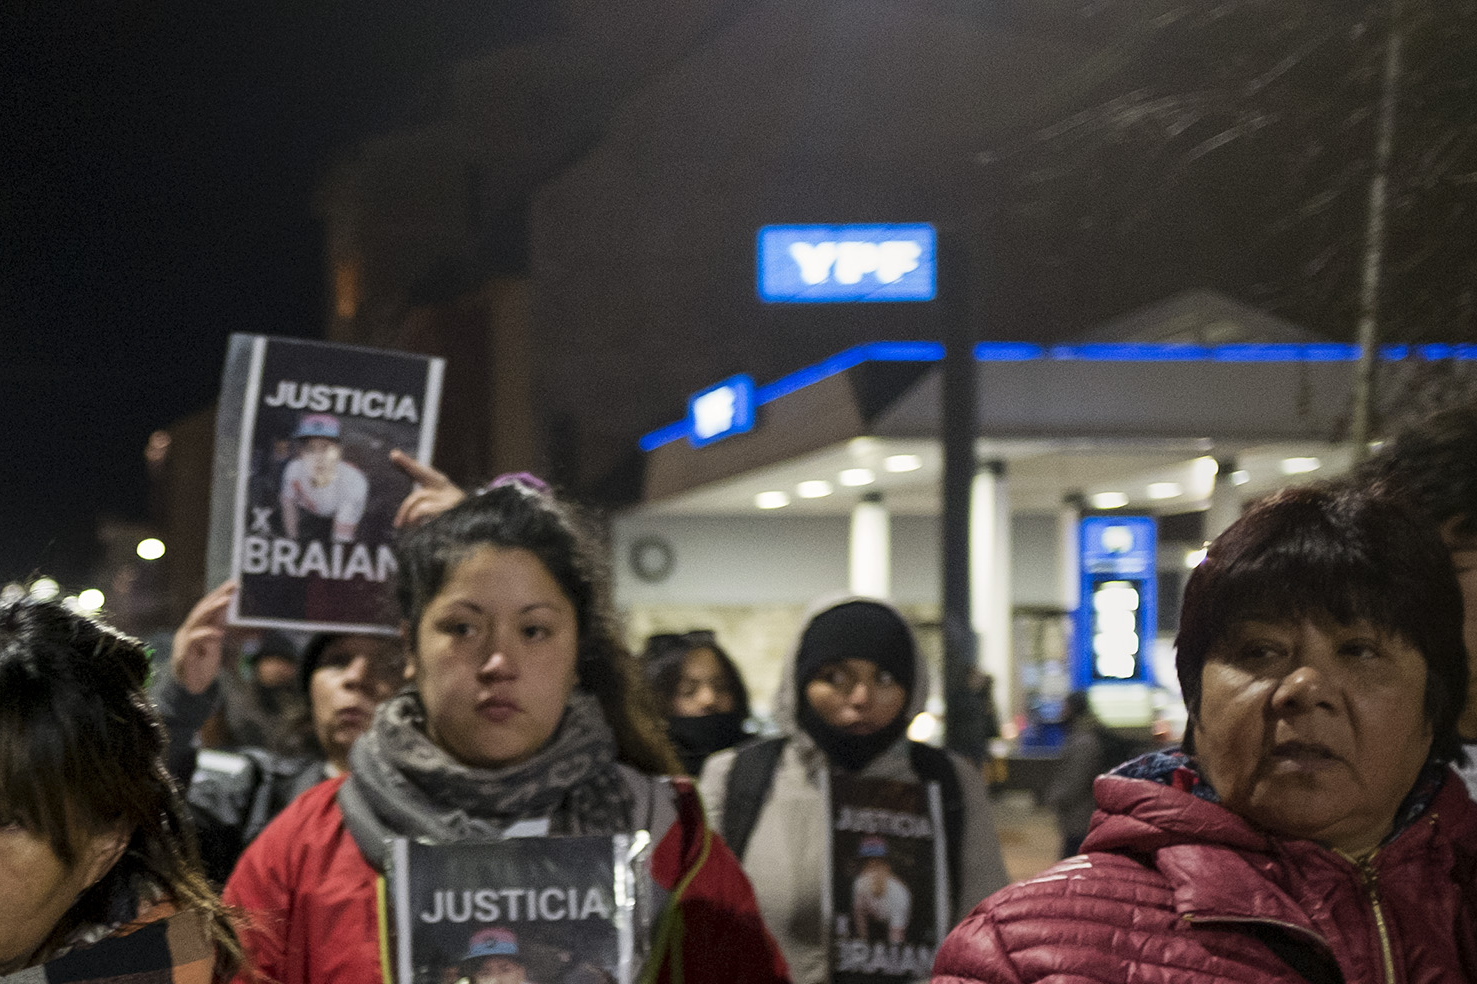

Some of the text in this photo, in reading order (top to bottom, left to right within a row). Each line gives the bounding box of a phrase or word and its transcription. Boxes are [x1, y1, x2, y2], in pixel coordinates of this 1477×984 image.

[789, 240, 922, 286] YPF
[265, 380, 419, 424] JUSTICIA
[422, 887, 611, 923] JUSTICIA
